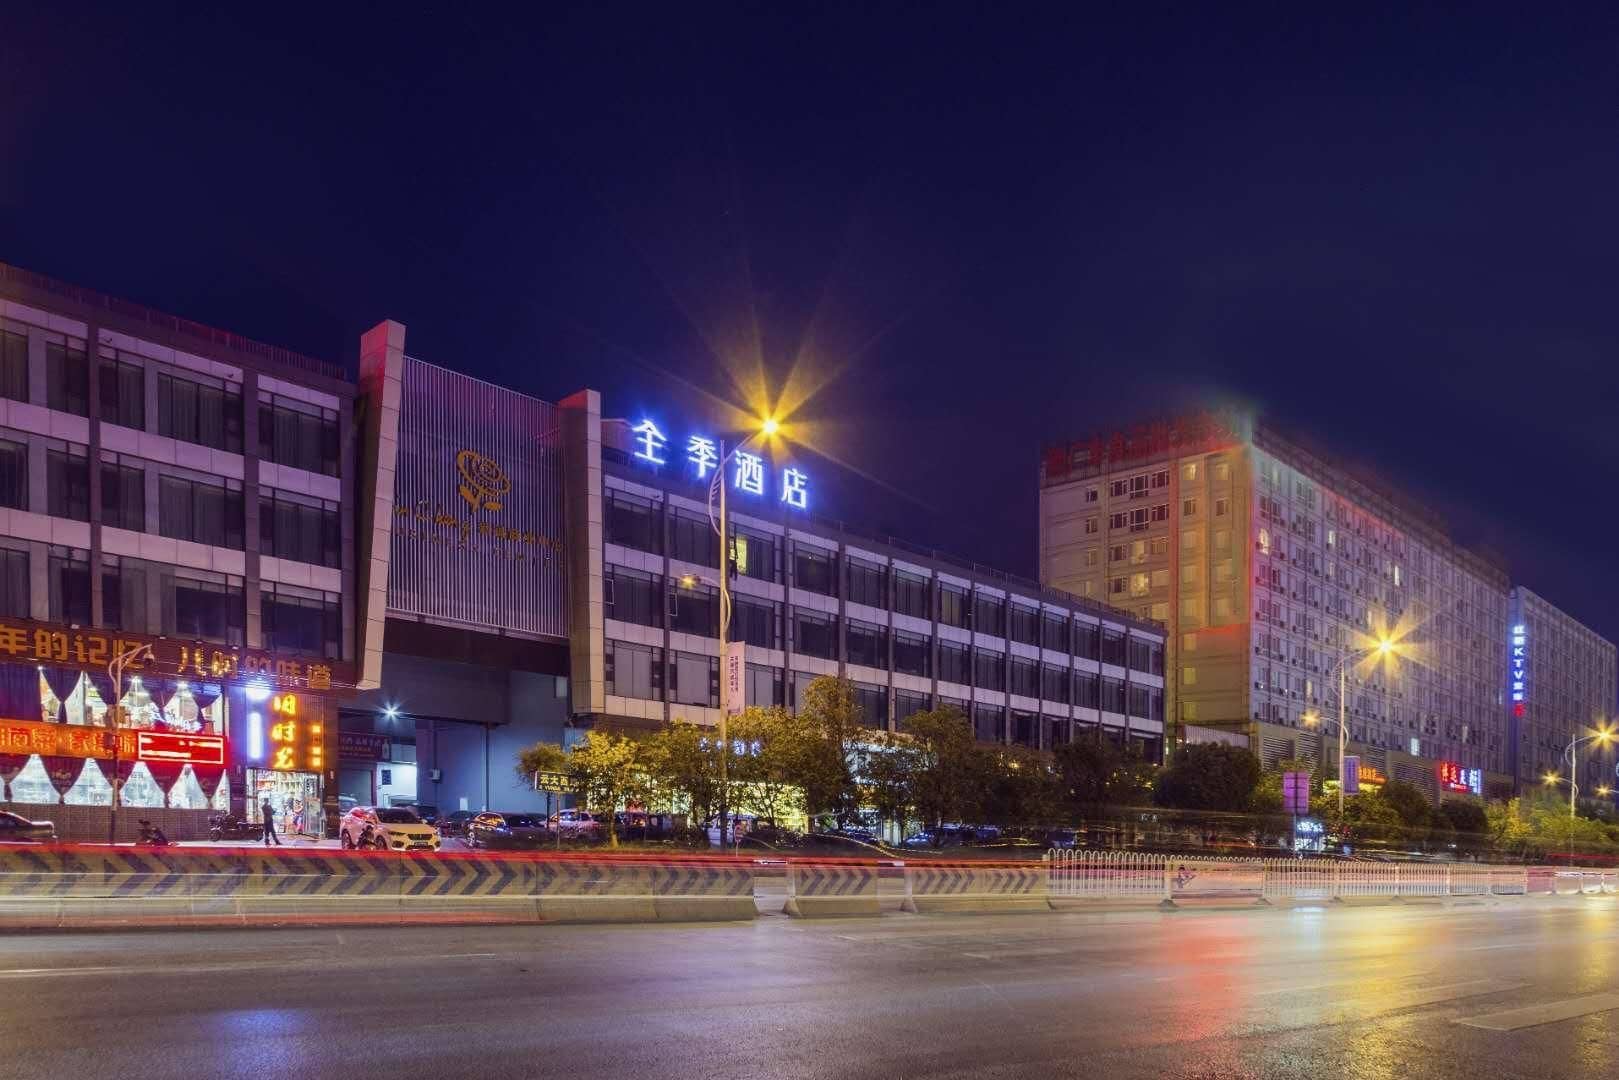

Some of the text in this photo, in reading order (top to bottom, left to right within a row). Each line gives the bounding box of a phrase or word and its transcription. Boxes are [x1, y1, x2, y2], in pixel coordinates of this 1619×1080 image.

[632, 419, 807, 509] 全季酒店
[0, 624, 332, 689] 年的记忆 儿时的味道
